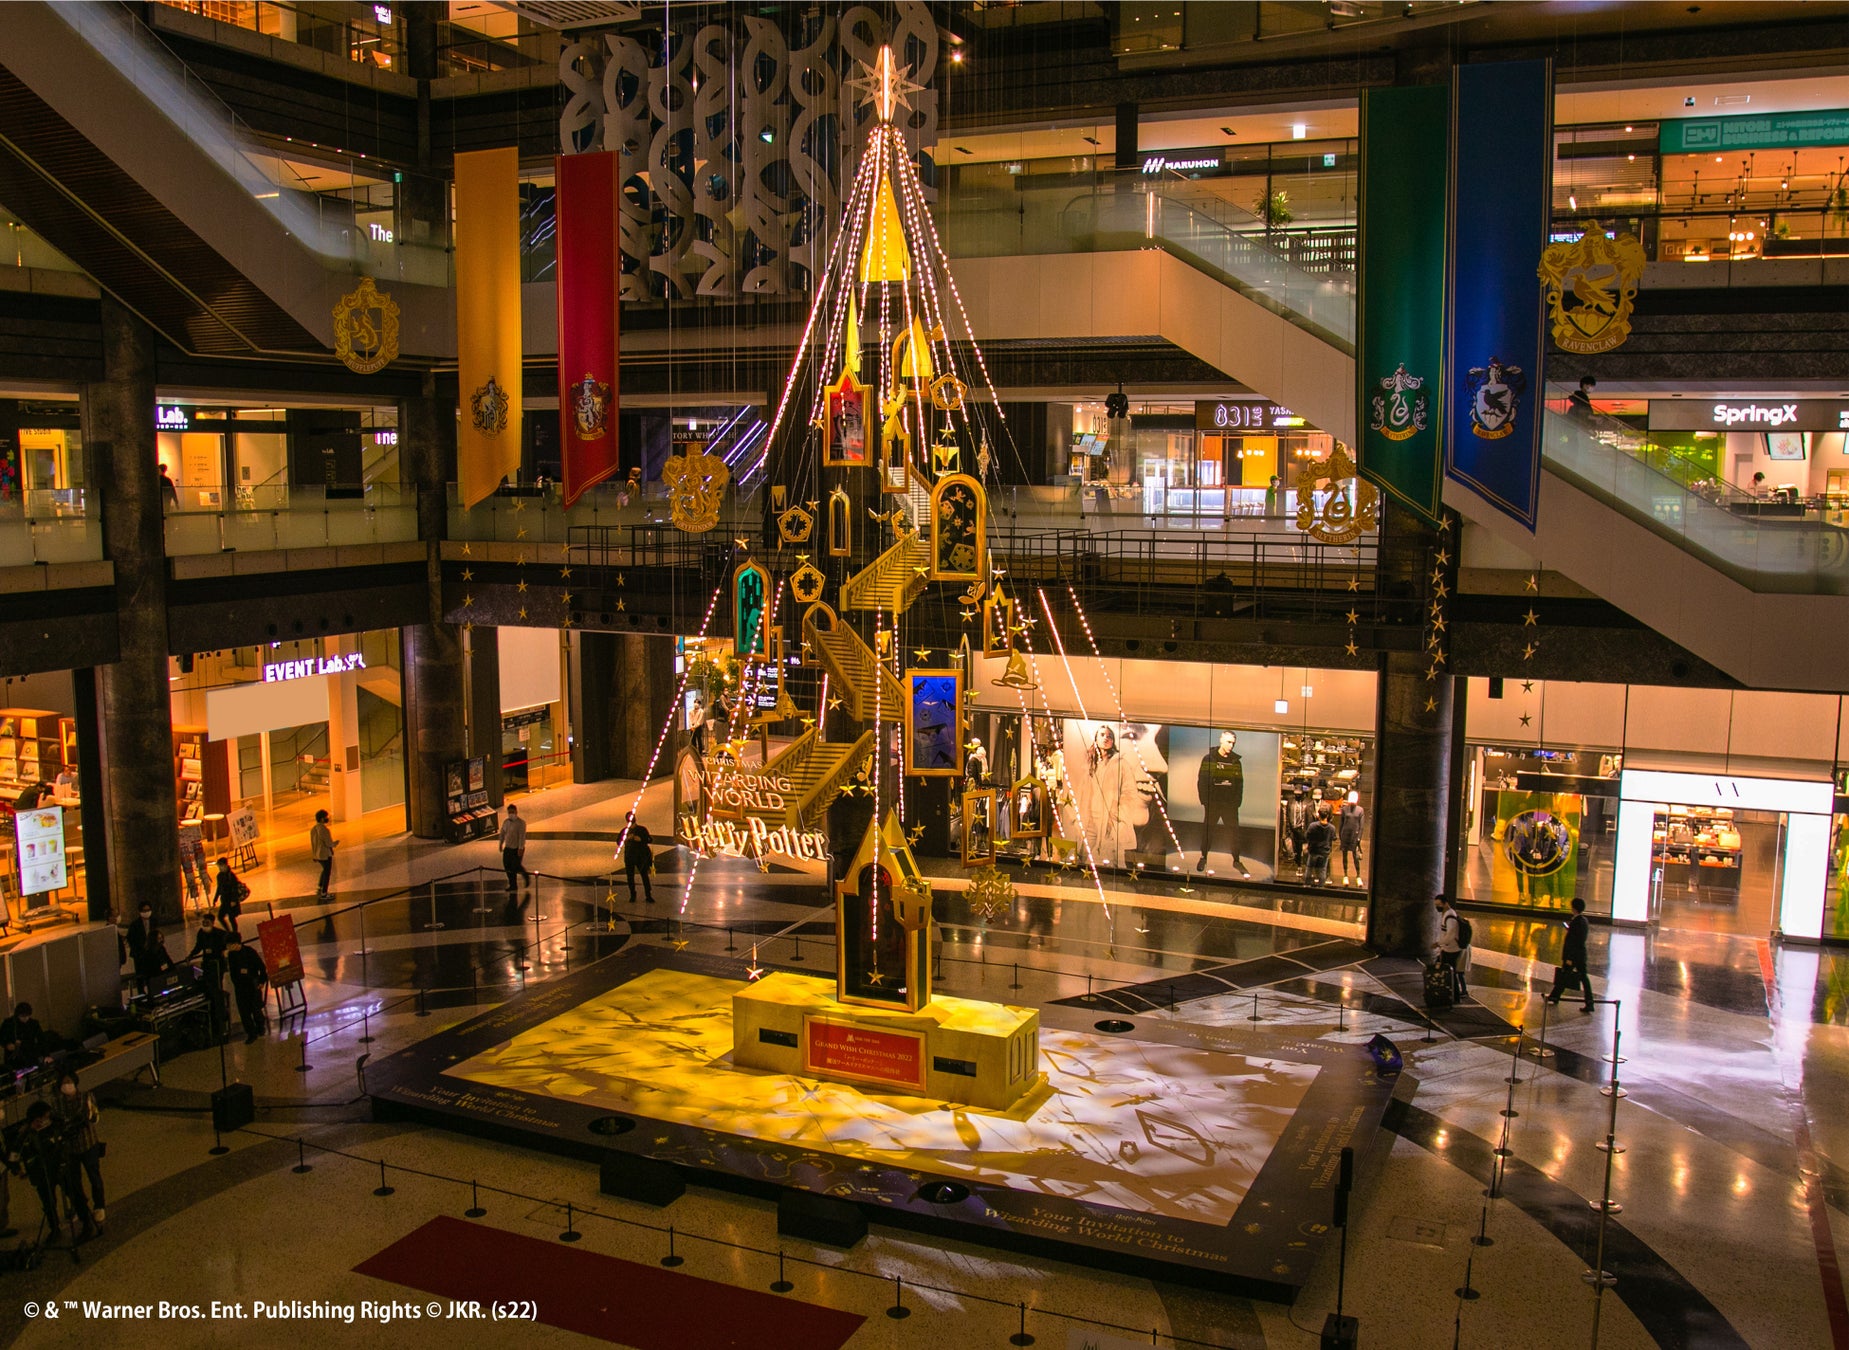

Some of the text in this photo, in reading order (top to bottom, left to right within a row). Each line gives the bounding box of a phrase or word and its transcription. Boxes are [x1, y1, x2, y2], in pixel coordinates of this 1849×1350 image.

[1723, 120, 1772, 134] NITORI
[1722, 130, 1788, 145] BUSINESS
[369, 223, 394, 243] The
[1562, 336, 1618, 352] RAVENCLAW
[347, 359, 386, 372] HUFFLEPUFF
[158, 406, 188, 424] Lab.
[1713, 404, 1798, 426] SpringX
[676, 521, 714, 532] GRYFFINDOR
[1315, 529, 1356, 543] SLYTHERIN
[265, 658, 314, 682] EVENT
[317, 655, 346, 675] Lab.
[705, 757, 763, 769] CHRISTMAS
[688, 769, 791, 792] WIZARDING
[704, 786, 786, 810] WORLD
[680, 815, 831, 866] Harry Potter
[858, 1045, 896, 1060] CHRISTMAS
[896, 1053, 913, 1062] 2022
[1033, 1207, 1073, 1222] Your
[1078, 1216, 1162, 1240] Invitation
[1167, 1232, 1184, 1244] to
[984, 1207, 1071, 1234] Wizarding
[1078, 1225, 1132, 1245] World
[1137, 1236, 1229, 1263] Christmas
